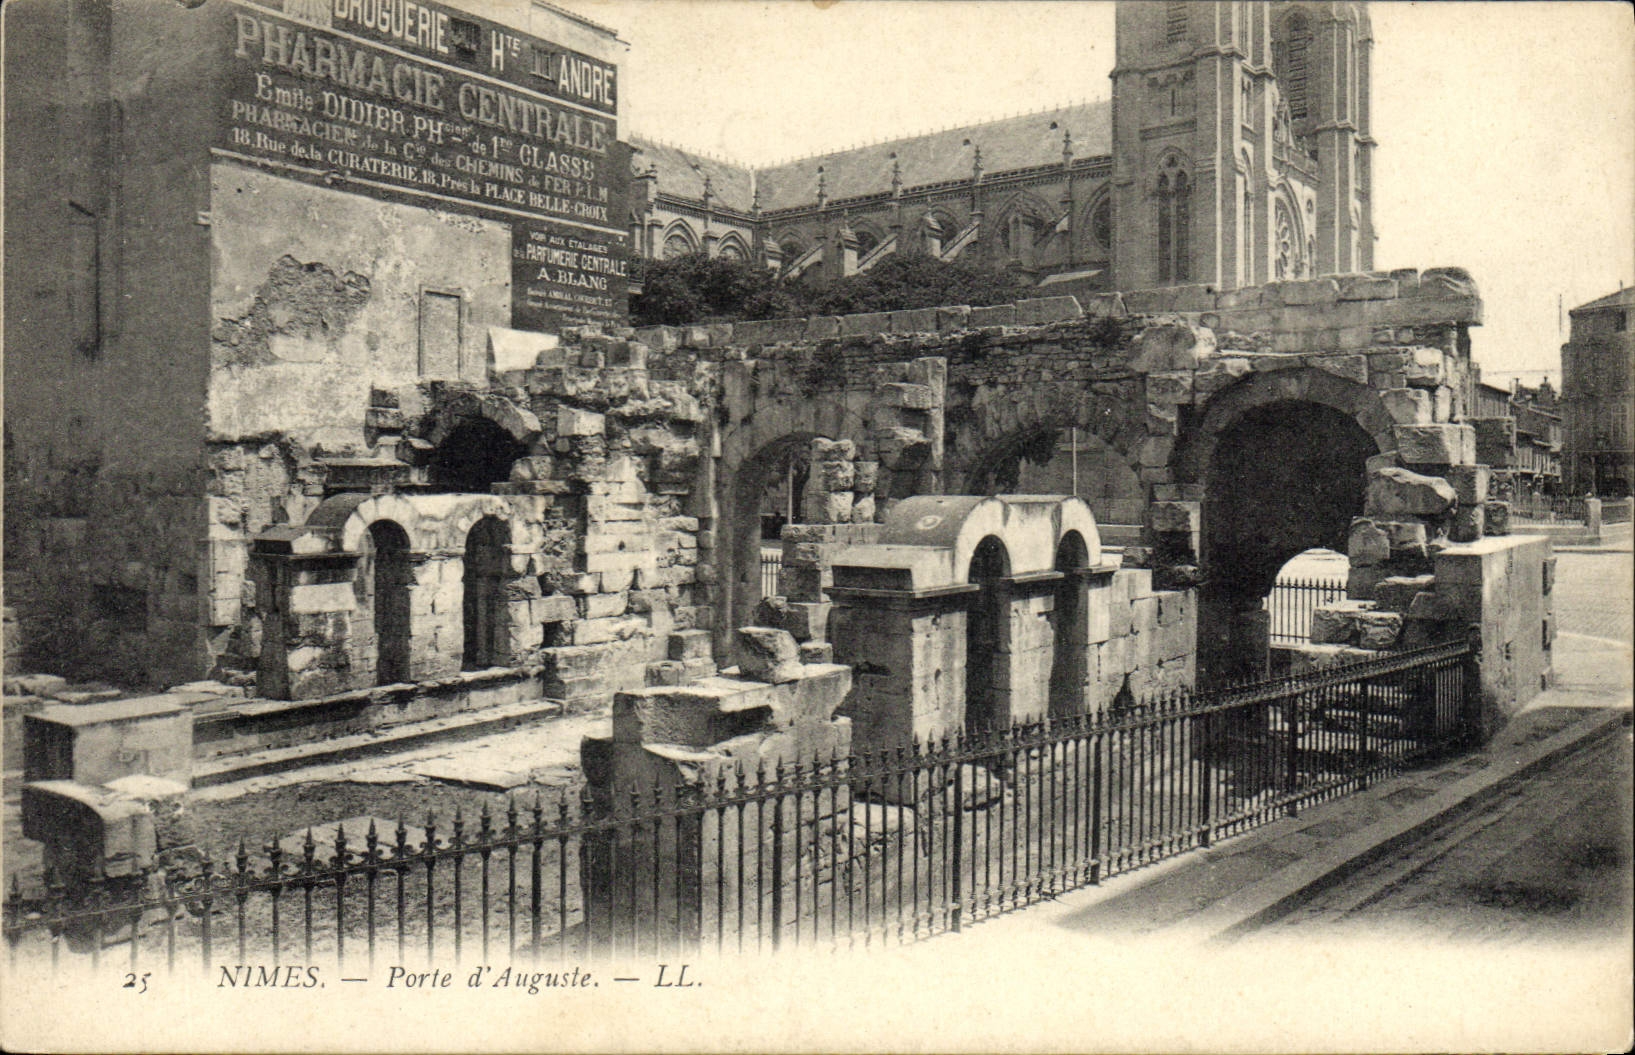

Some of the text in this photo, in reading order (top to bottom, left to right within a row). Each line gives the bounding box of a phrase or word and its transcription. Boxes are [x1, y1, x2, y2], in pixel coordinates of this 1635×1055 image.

[234, 13, 607, 153] PHARMACIE CENTRALE
[384, 139, 397, 156] la
[455, 154, 524, 184] CHEMINS
[544, 175, 571, 197] FER
[519, 143, 595, 181] CLASSE
[471, 179, 481, 195] la
[485, 182, 526, 205] PLACE
[549, 236, 566, 246] AUX
[526, 243, 579, 269] PARFUMERIE
[581, 253, 627, 277] CENTRALE
[556, 269, 607, 291] BLANC
